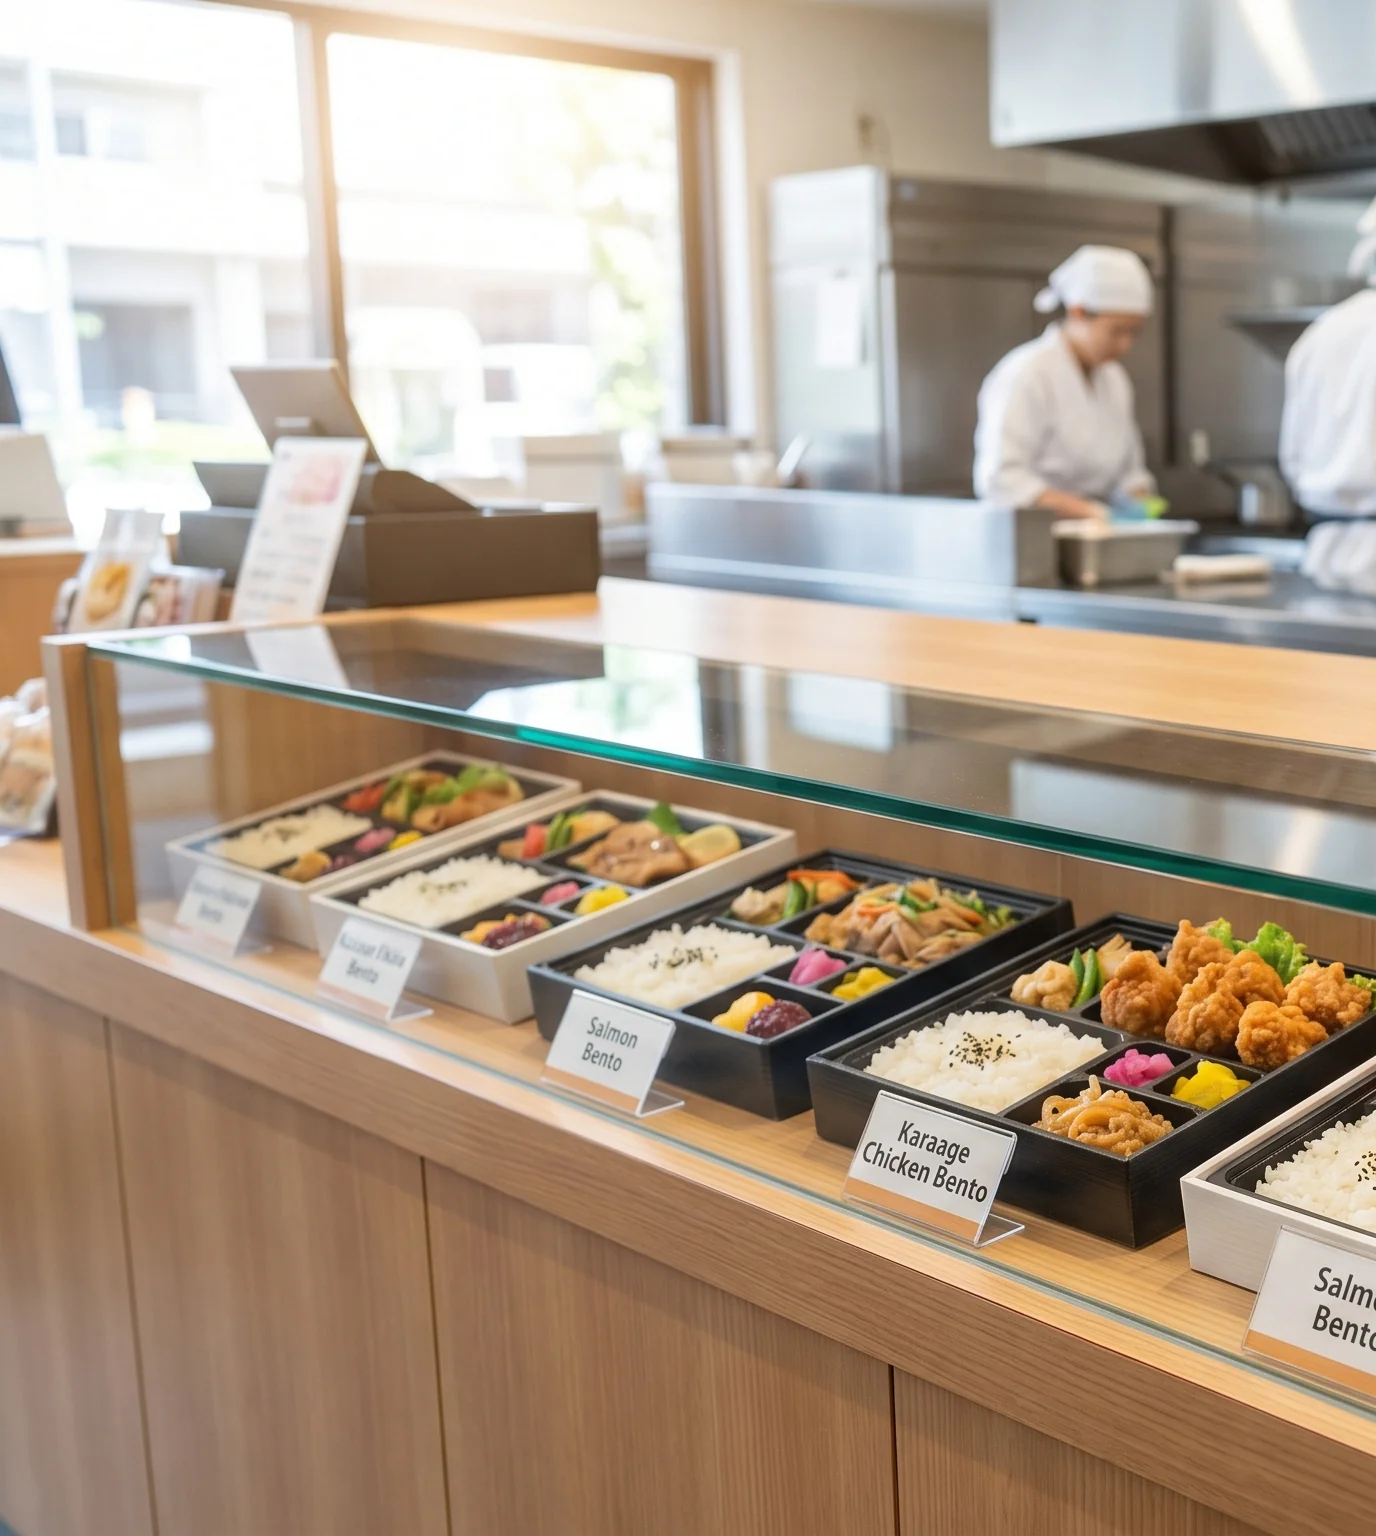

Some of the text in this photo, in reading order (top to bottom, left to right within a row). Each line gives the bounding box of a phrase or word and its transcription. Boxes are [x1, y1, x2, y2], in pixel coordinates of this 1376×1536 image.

[586, 1015, 639, 1050] Salmon
[581, 1041, 623, 1072] Bento
[897, 1120, 971, 1166] Karaage
[862, 1141, 988, 1203] Chicken Bento
